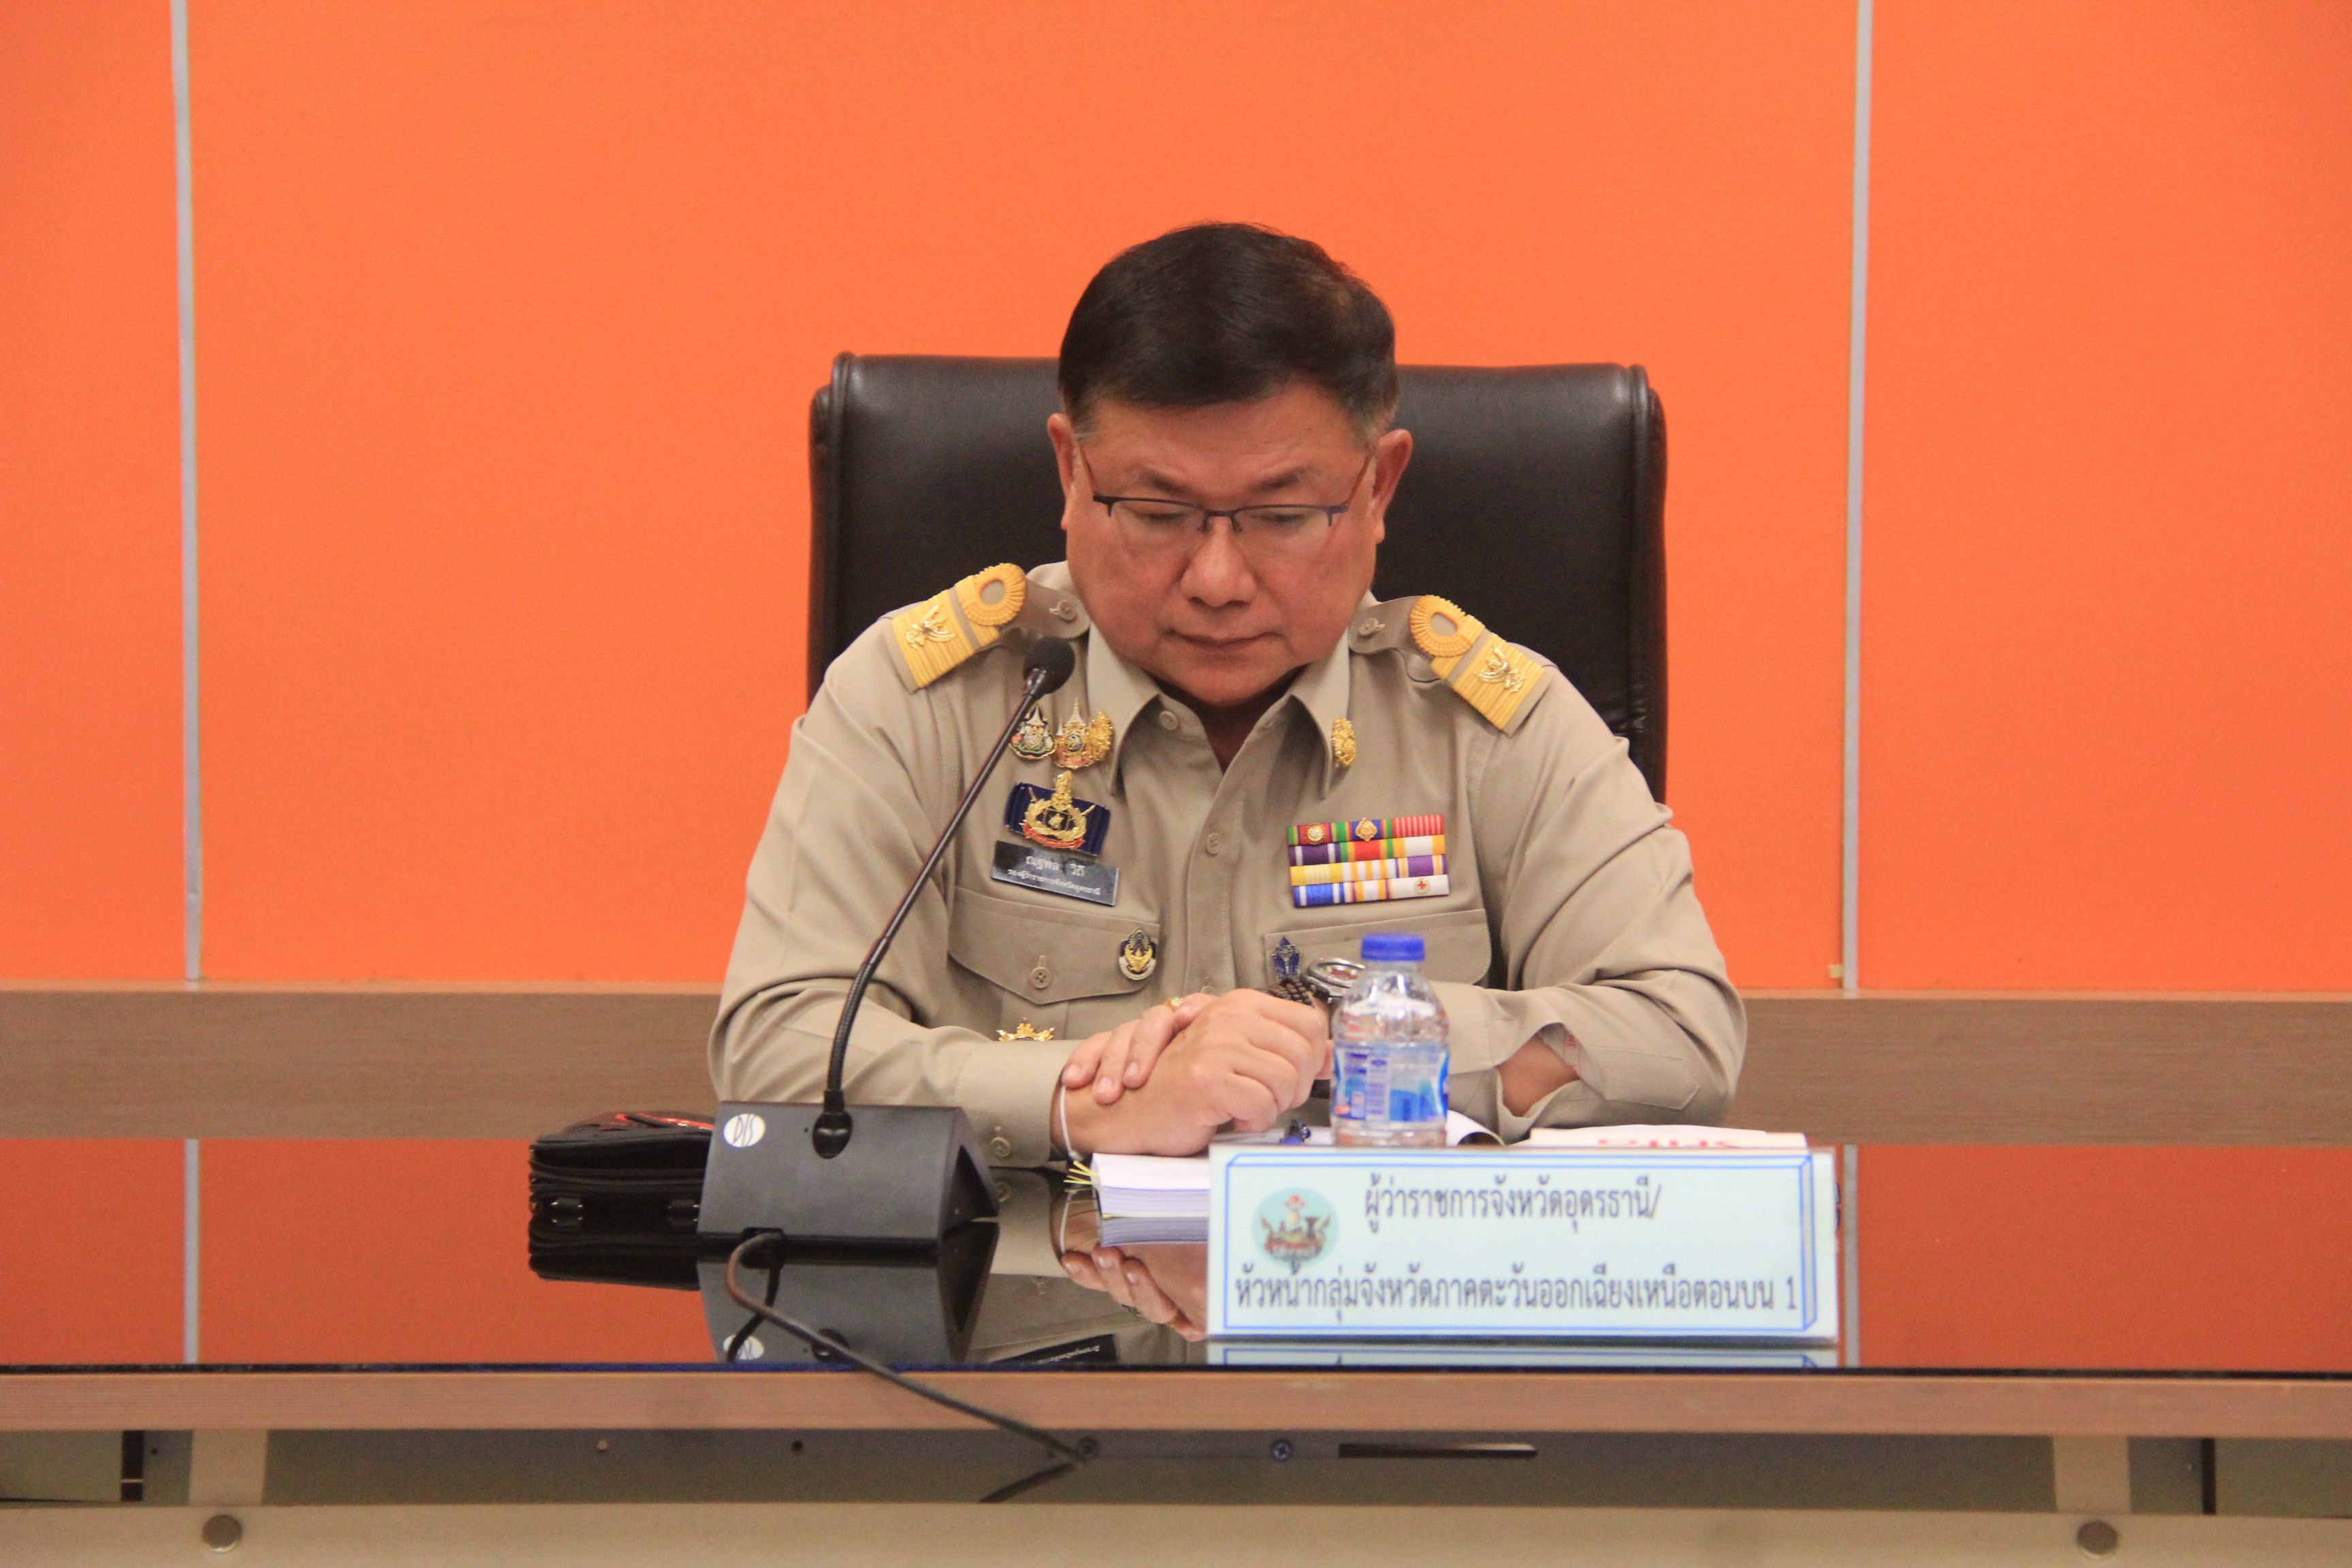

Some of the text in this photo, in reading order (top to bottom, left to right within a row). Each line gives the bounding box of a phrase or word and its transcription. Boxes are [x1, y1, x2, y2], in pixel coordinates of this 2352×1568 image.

[1365, 1173, 1661, 1232] ผู้ว่าราชการจังหวัดอุดรธานี/
[1786, 1276, 1796, 1309] 1
